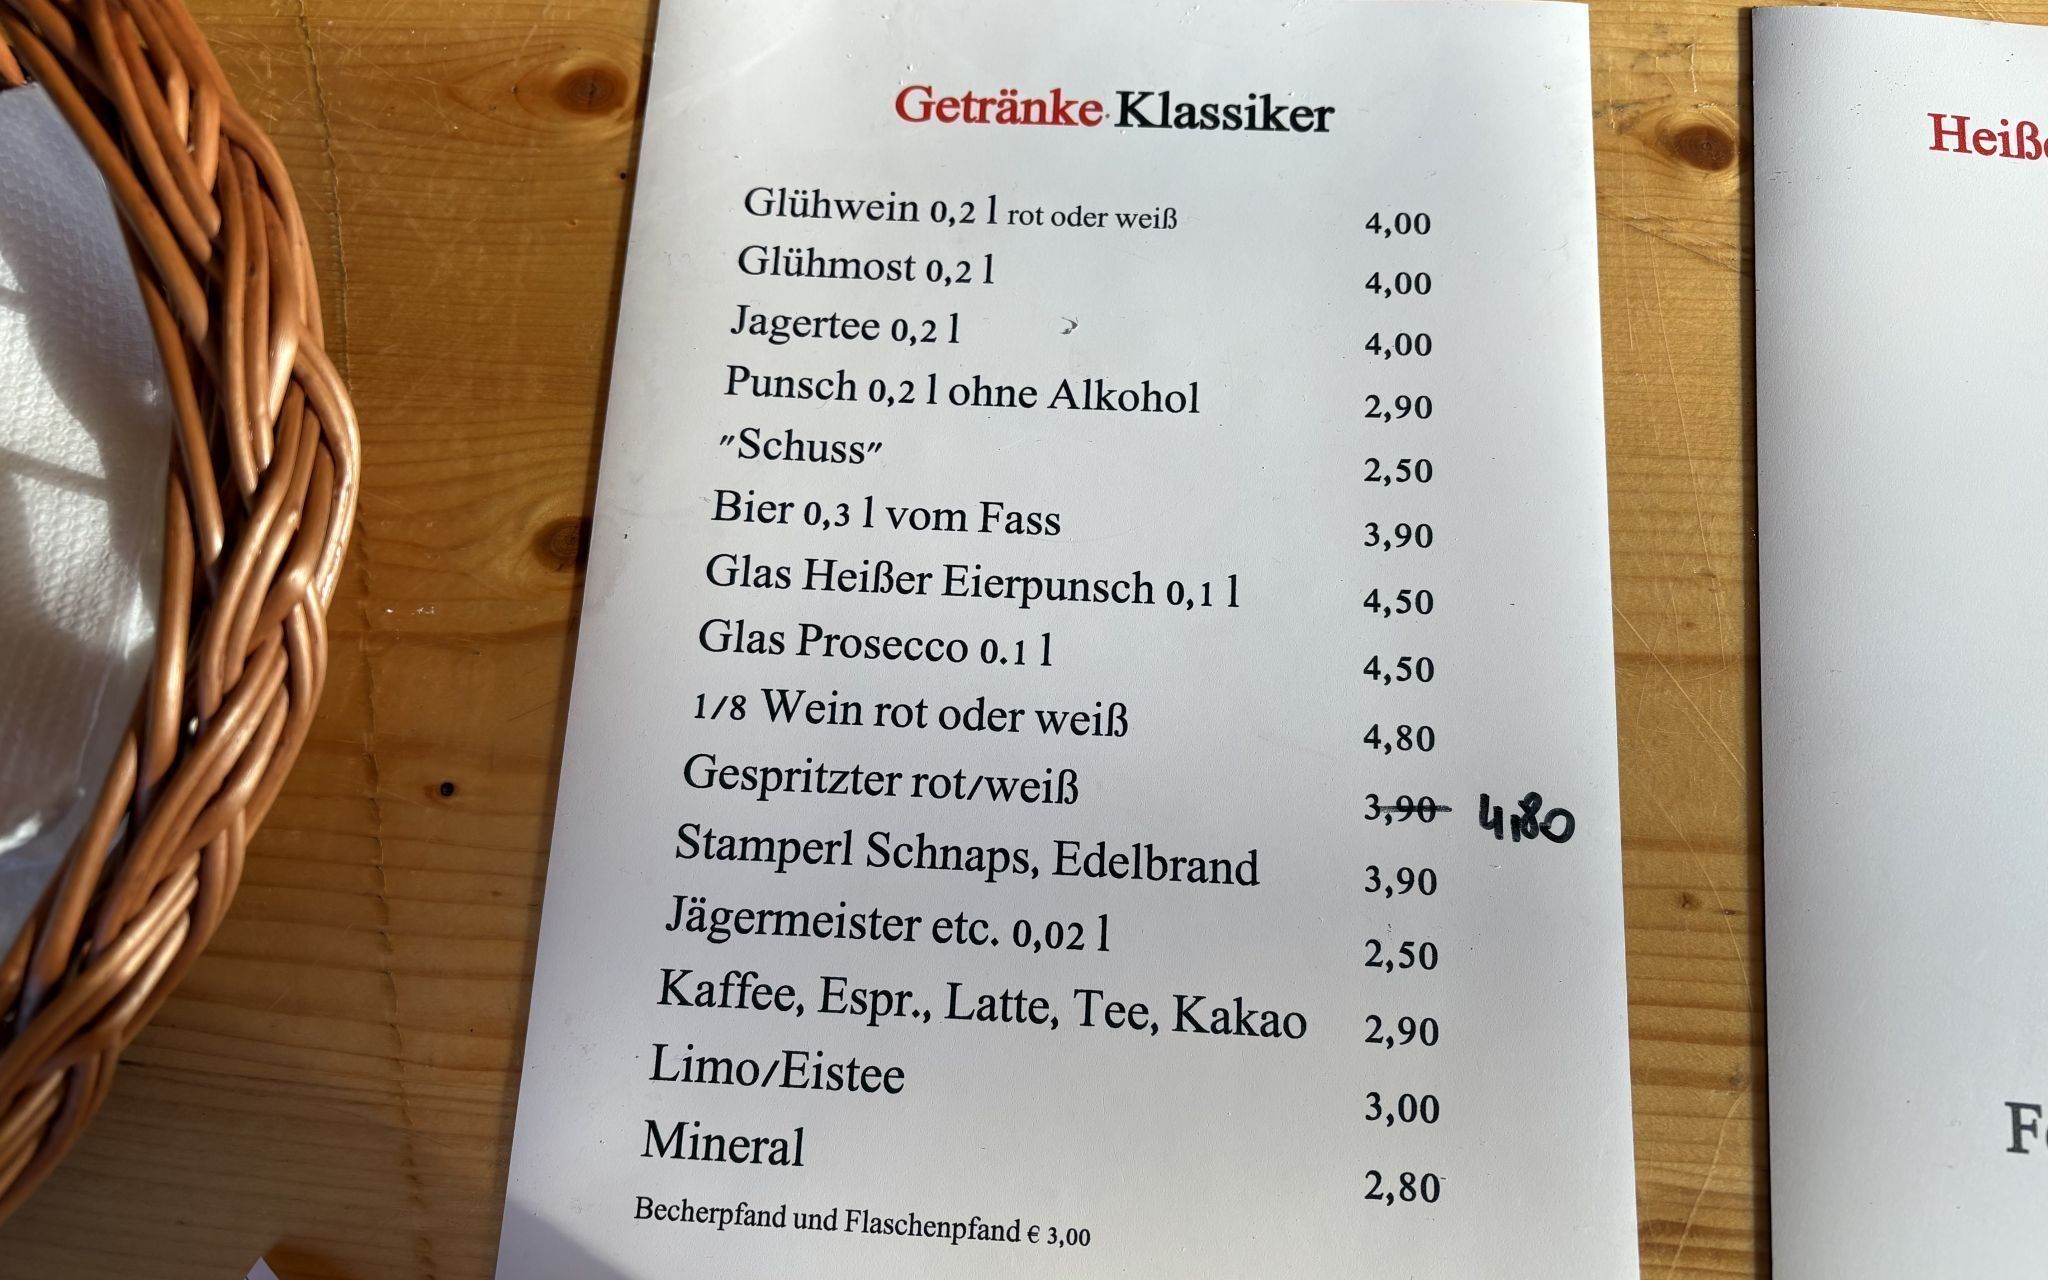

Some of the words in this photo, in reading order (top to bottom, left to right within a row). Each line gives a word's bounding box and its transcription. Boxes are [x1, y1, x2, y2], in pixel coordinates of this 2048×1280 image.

[894, 84, 1104, 128] Getränke
[1113, 89, 1336, 134] Klassiker
[1926, 112, 2048, 161] Heiß
[743, 186, 921, 223] Glühwein
[930, 200, 976, 228] 0,2
[986, 193, 998, 225] l
[1007, 206, 1045, 227] rot
[1050, 204, 1110, 228] oder
[1114, 206, 1178, 230] weiß
[1364, 211, 1432, 240] 4,00
[737, 244, 917, 282] Glühmost
[925, 259, 973, 288] 0,2
[982, 253, 995, 285] l
[1364, 271, 1432, 300] 4,00
[729, 304, 881, 346] Jagertee
[890, 318, 938, 347] 0,2
[947, 312, 960, 344] l
[1364, 332, 1433, 361] 4,00
[723, 364, 858, 402] Punsch
[868, 378, 916, 408] 0,2
[925, 372, 938, 405] l
[948, 374, 1038, 409] ohne
[1046, 377, 1201, 414] Alkohol
[1364, 393, 1433, 424] 2,90
[1363, 457, 1433, 488] 2,50
[710, 488, 796, 525] Bier
[803, 501, 850, 532] 0,3
[862, 495, 875, 529] l
[884, 506, 969, 533] vom
[977, 500, 1061, 537] Fass
[1363, 521, 1434, 553] 3,90
[705, 553, 792, 590] Glas
[801, 557, 934, 596] Heißer
[940, 563, 1156, 610] Eierpunsch
[1166, 580, 1213, 611] 0,1
[1227, 573, 1240, 608] l
[1363, 587, 1434, 619] 4,50
[698, 618, 786, 656] Glas
[795, 622, 969, 664] Prosecco
[980, 638, 1026, 666] 0.1
[1039, 631, 1053, 667] l
[1362, 654, 1435, 687] 4,50
[693, 692, 747, 721] 1/8
[760, 687, 864, 726] Wein
[872, 697, 929, 729] rot
[938, 695, 1026, 733] oder
[1033, 700, 1129, 738] weiß
[1363, 723, 1436, 756] 4,80
[683, 753, 904, 802] Gespritzter
[910, 767, 1079, 805] rot/weiß
[675, 822, 854, 874] Stamperl
[866, 830, 1039, 884] Schnaps,
[1051, 839, 1261, 887] Edelbrand
[1364, 864, 1438, 900] 3,90
[664, 894, 923, 945] Jägermeister
[931, 911, 1000, 948] etc.
[1012, 919, 1085, 954] 0,02
[1097, 913, 1110, 952] l
[1364, 938, 1439, 974] 2,50
[656, 968, 805, 1018] Kaffee,
[816, 975, 932, 1028] Espr.,
[943, 981, 1059, 1031] Latte,
[1073, 988, 1159, 1037] Tee,
[1171, 993, 1308, 1040] Kakao
[1364, 1014, 1440, 1050] 2,90
[648, 1043, 905, 1095] Limo/Eistee
[1364, 1091, 1440, 1128] 3,00
[639, 1119, 805, 1167] Mineral
[1364, 1169, 1441, 1207] 2,80
[633, 1195, 787, 1232] Becherpfand
[792, 1207, 839, 1232] und
[843, 1208, 1022, 1246] Flaschenpfand
[1026, 1224, 1041, 1244] €
[1046, 1226, 1091, 1249] 3,00
